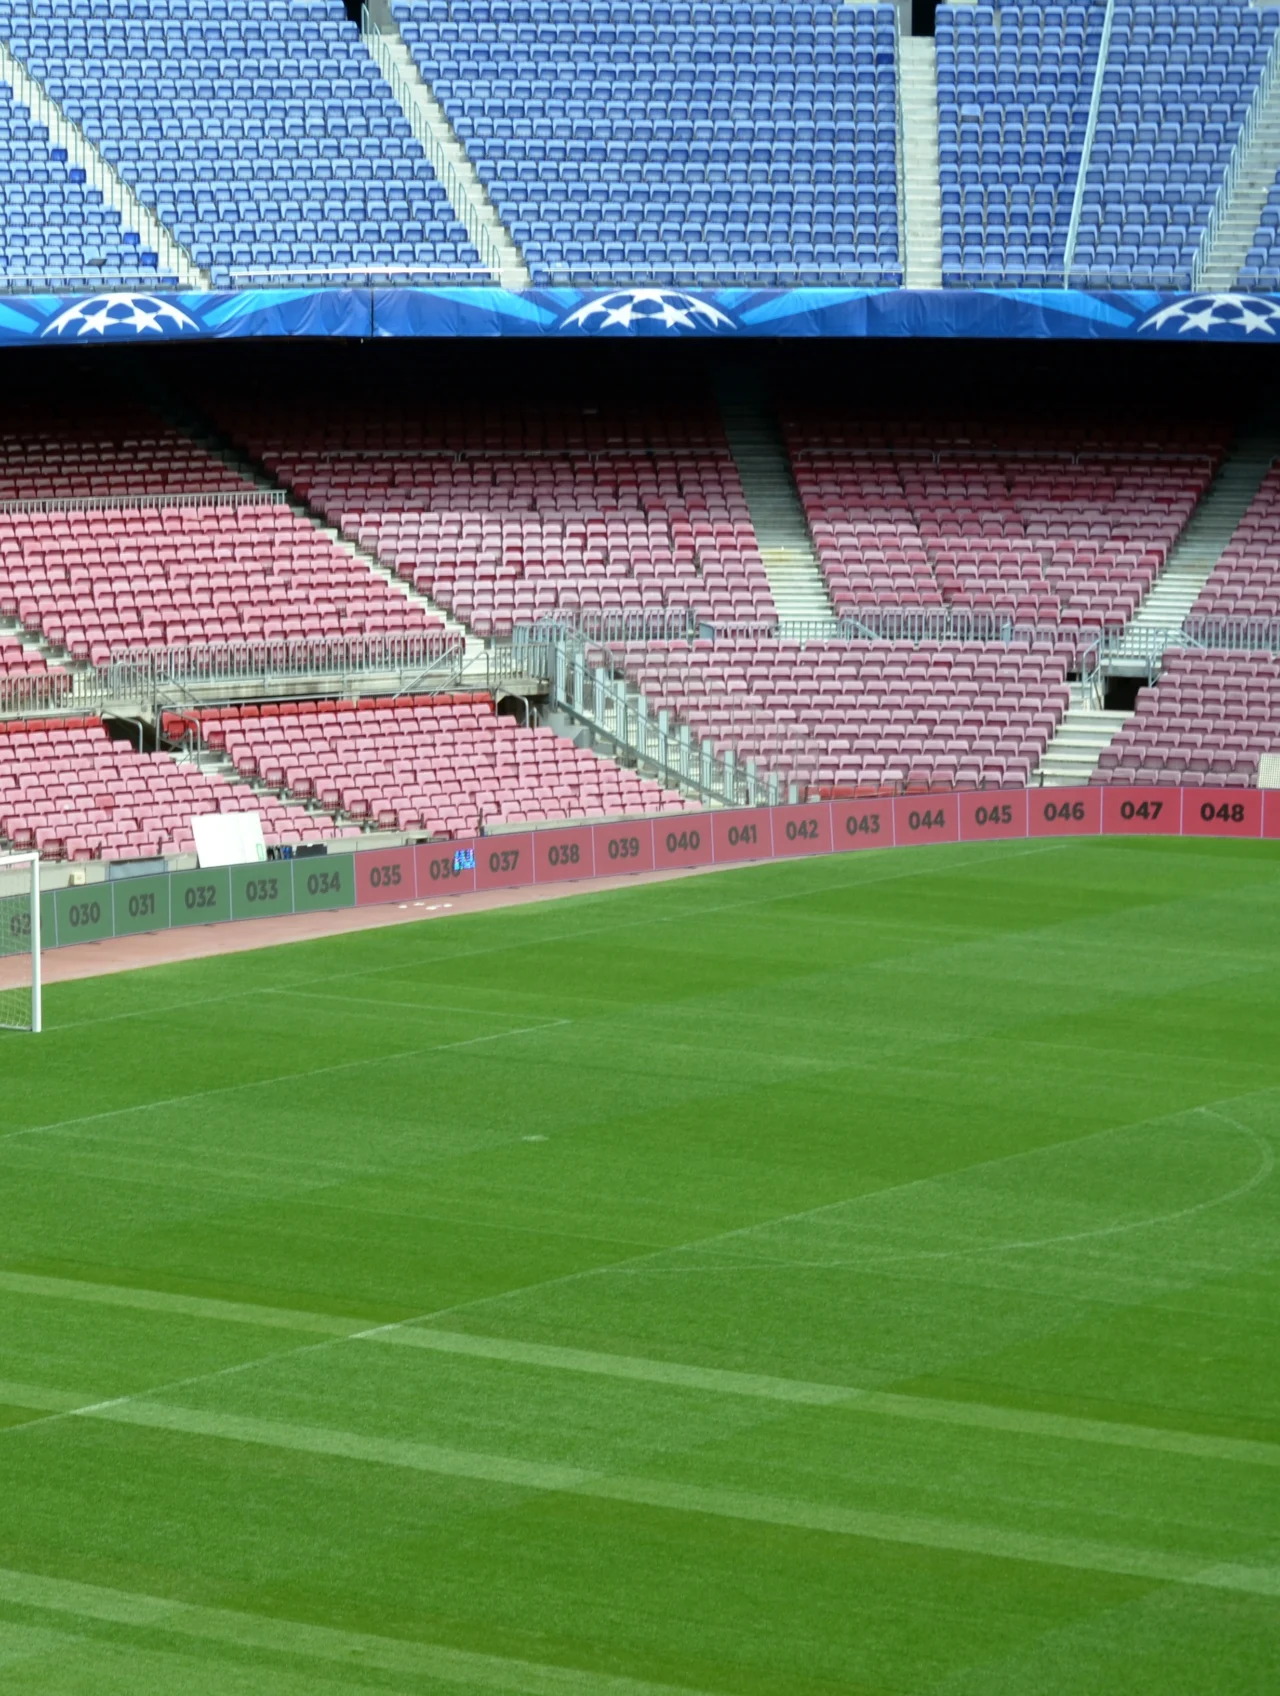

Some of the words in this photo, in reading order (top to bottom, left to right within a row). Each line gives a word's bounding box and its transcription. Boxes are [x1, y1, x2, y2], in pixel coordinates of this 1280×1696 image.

[908, 809, 946, 831] 044
[974, 804, 1013, 826] 045
[1043, 801, 1085, 822] 046
[1120, 800, 1163, 820] 047
[1200, 802, 1245, 823] 048
[727, 823, 757, 846] 041
[785, 819, 819, 841] 042
[846, 814, 881, 836] 043
[607, 837, 640, 860] 039
[665, 830, 701, 853] 040
[488, 849, 520, 873] 037
[547, 843, 581, 866] 038
[306, 871, 341, 896] 034
[369, 863, 402, 888] 035
[184, 884, 217, 910] 032
[245, 878, 279, 903] 033
[69, 901, 101, 927] 030
[128, 892, 155, 918] 031
[10, 912, 42, 936] 02
